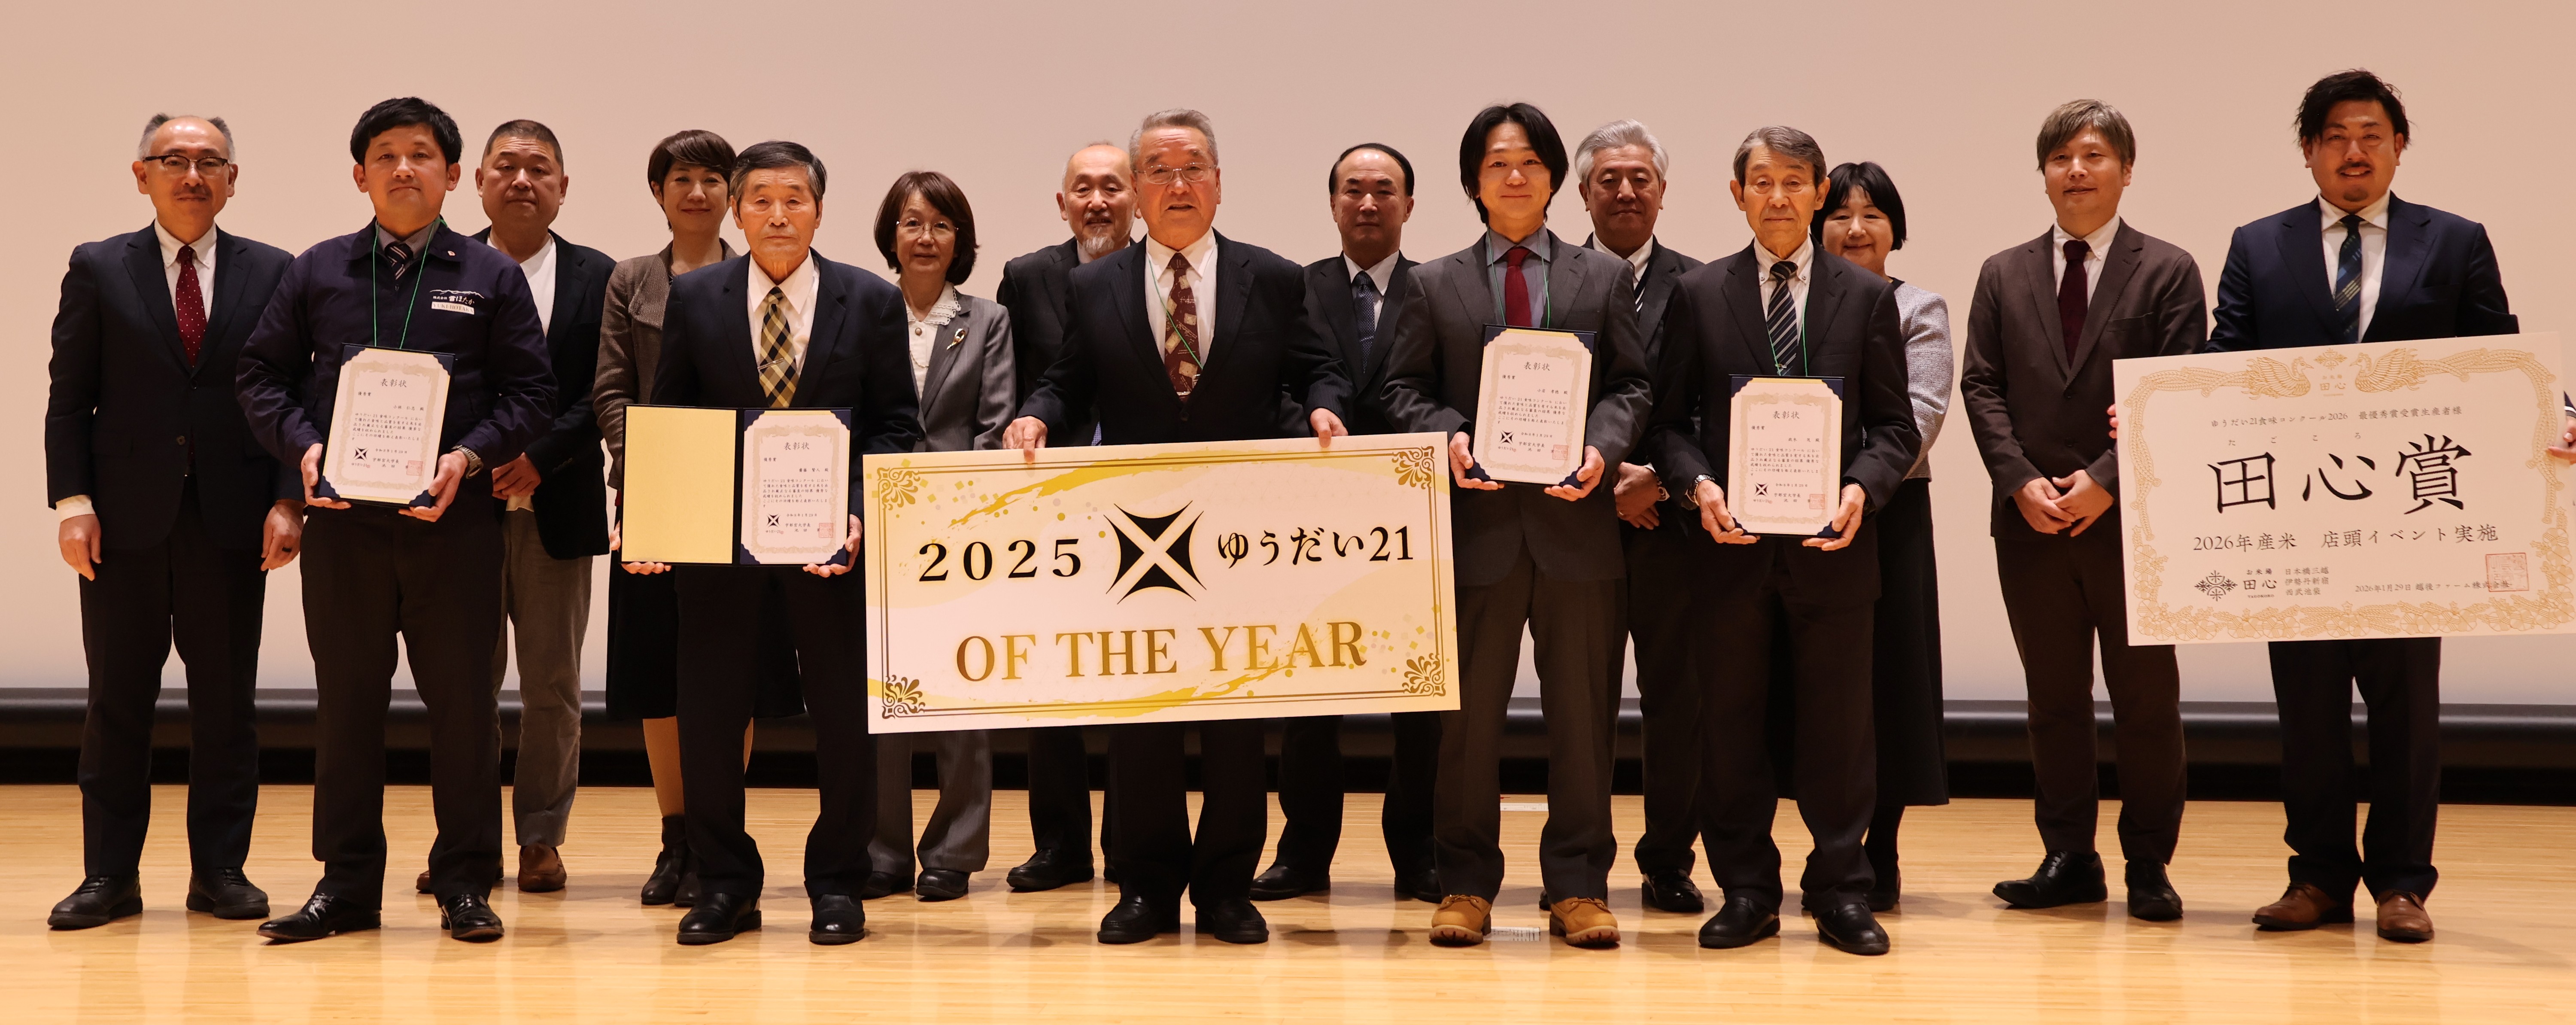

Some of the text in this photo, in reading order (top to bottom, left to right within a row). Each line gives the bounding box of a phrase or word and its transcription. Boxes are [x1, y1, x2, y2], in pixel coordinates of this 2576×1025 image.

[1524, 362, 1550, 371] 表彰状
[380, 378, 407, 387] 表彰状
[1773, 411, 1800, 419] 表彰状
[2211, 406, 2462, 428] ゆうだい21食味コンクール2026 最優秀賞受賞生産者様
[784, 442, 810, 450] 表彰状
[2207, 433, 2472, 514] 田心賞
[2193, 523, 2499, 553] 2026年産米 店頭イベント実施
[919, 526, 1414, 582] 2025 ゆうだい21
[2285, 566, 2329, 575] 日本橋三越
[2243, 579, 2277, 590] 田心
[2355, 583, 2411, 593] 2026年1月29日
[957, 621, 1367, 682] OF THE YEAR
